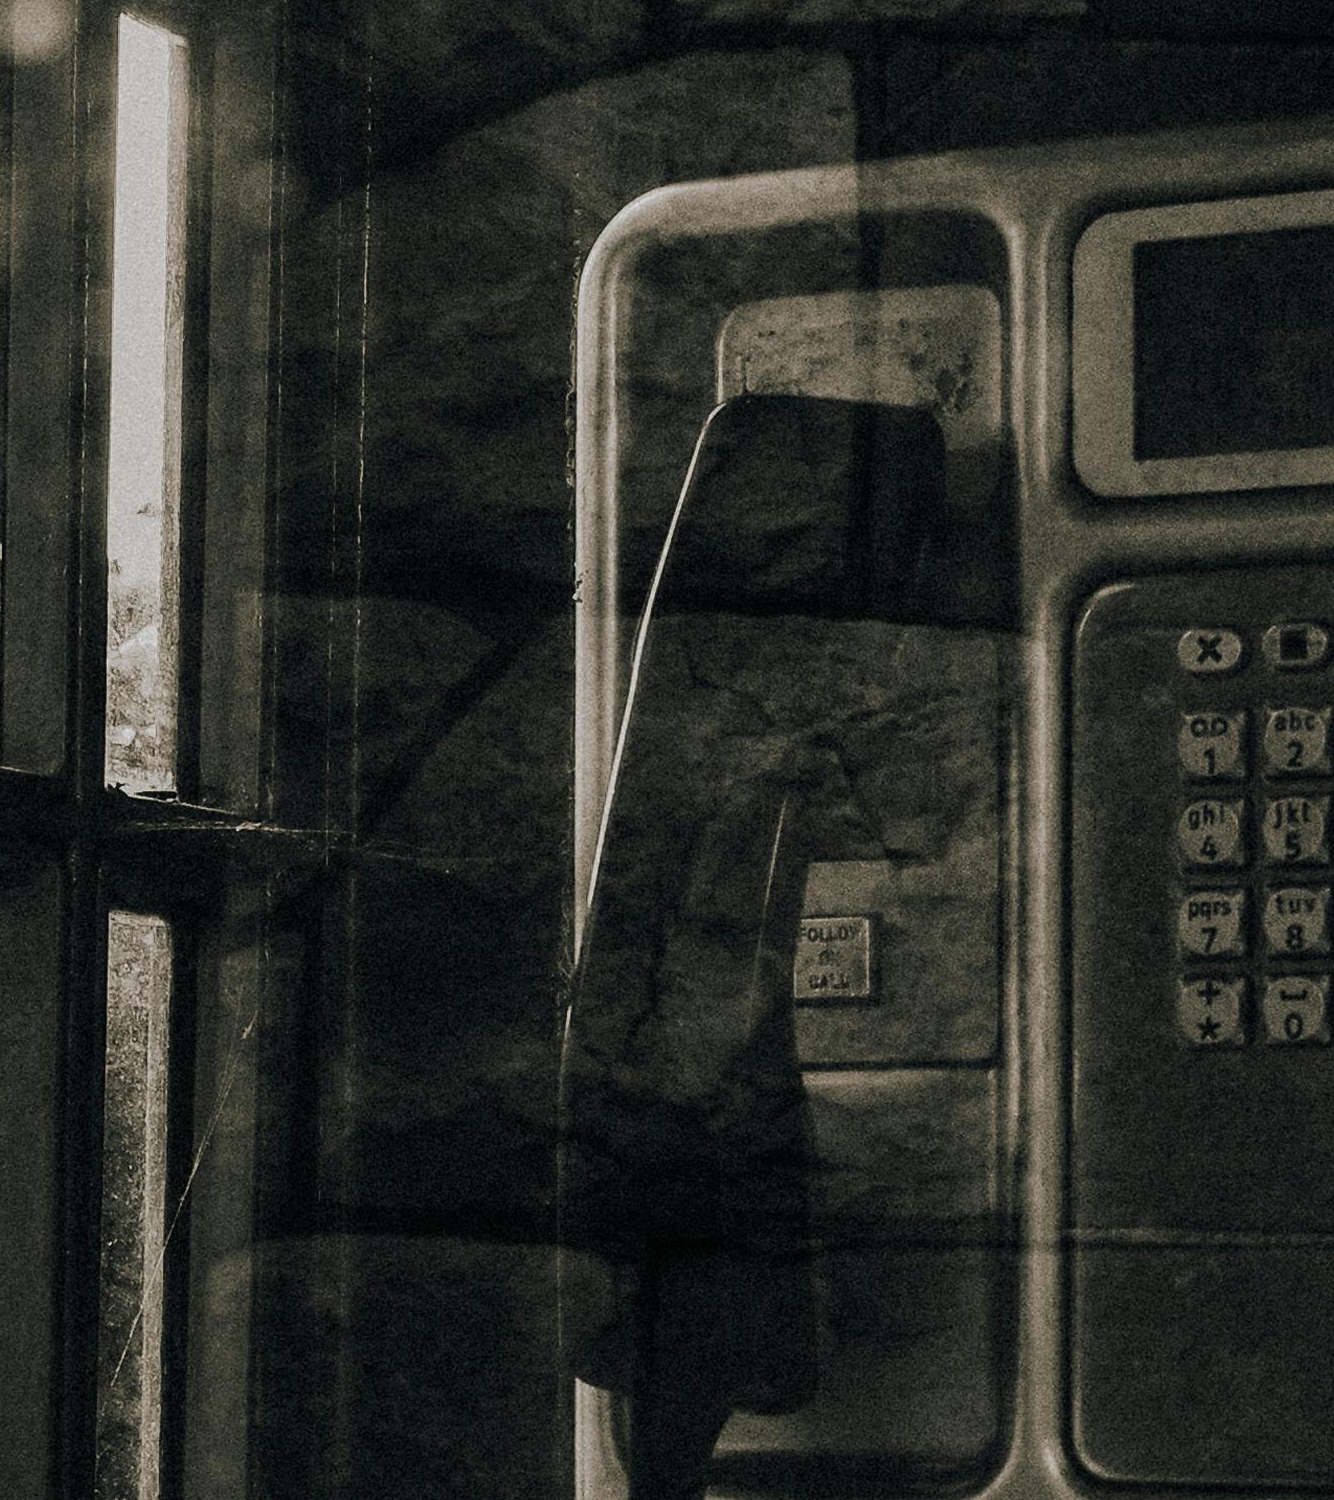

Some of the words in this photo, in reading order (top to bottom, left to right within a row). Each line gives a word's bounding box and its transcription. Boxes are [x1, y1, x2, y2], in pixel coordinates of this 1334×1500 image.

[1274, 712, 1316, 731] abc
[1203, 748, 1216, 775] 1
[1286, 741, 1304, 766] 2
[1200, 835, 1217, 860] 4
[1284, 831, 1301, 860] 5
[1188, 899, 1232, 921] pqrs
[1276, 895, 1316, 915] tuv
[1200, 926, 1218, 952] 7
[1286, 923, 1304, 950] 8
[1284, 1012, 1303, 1040] 0
